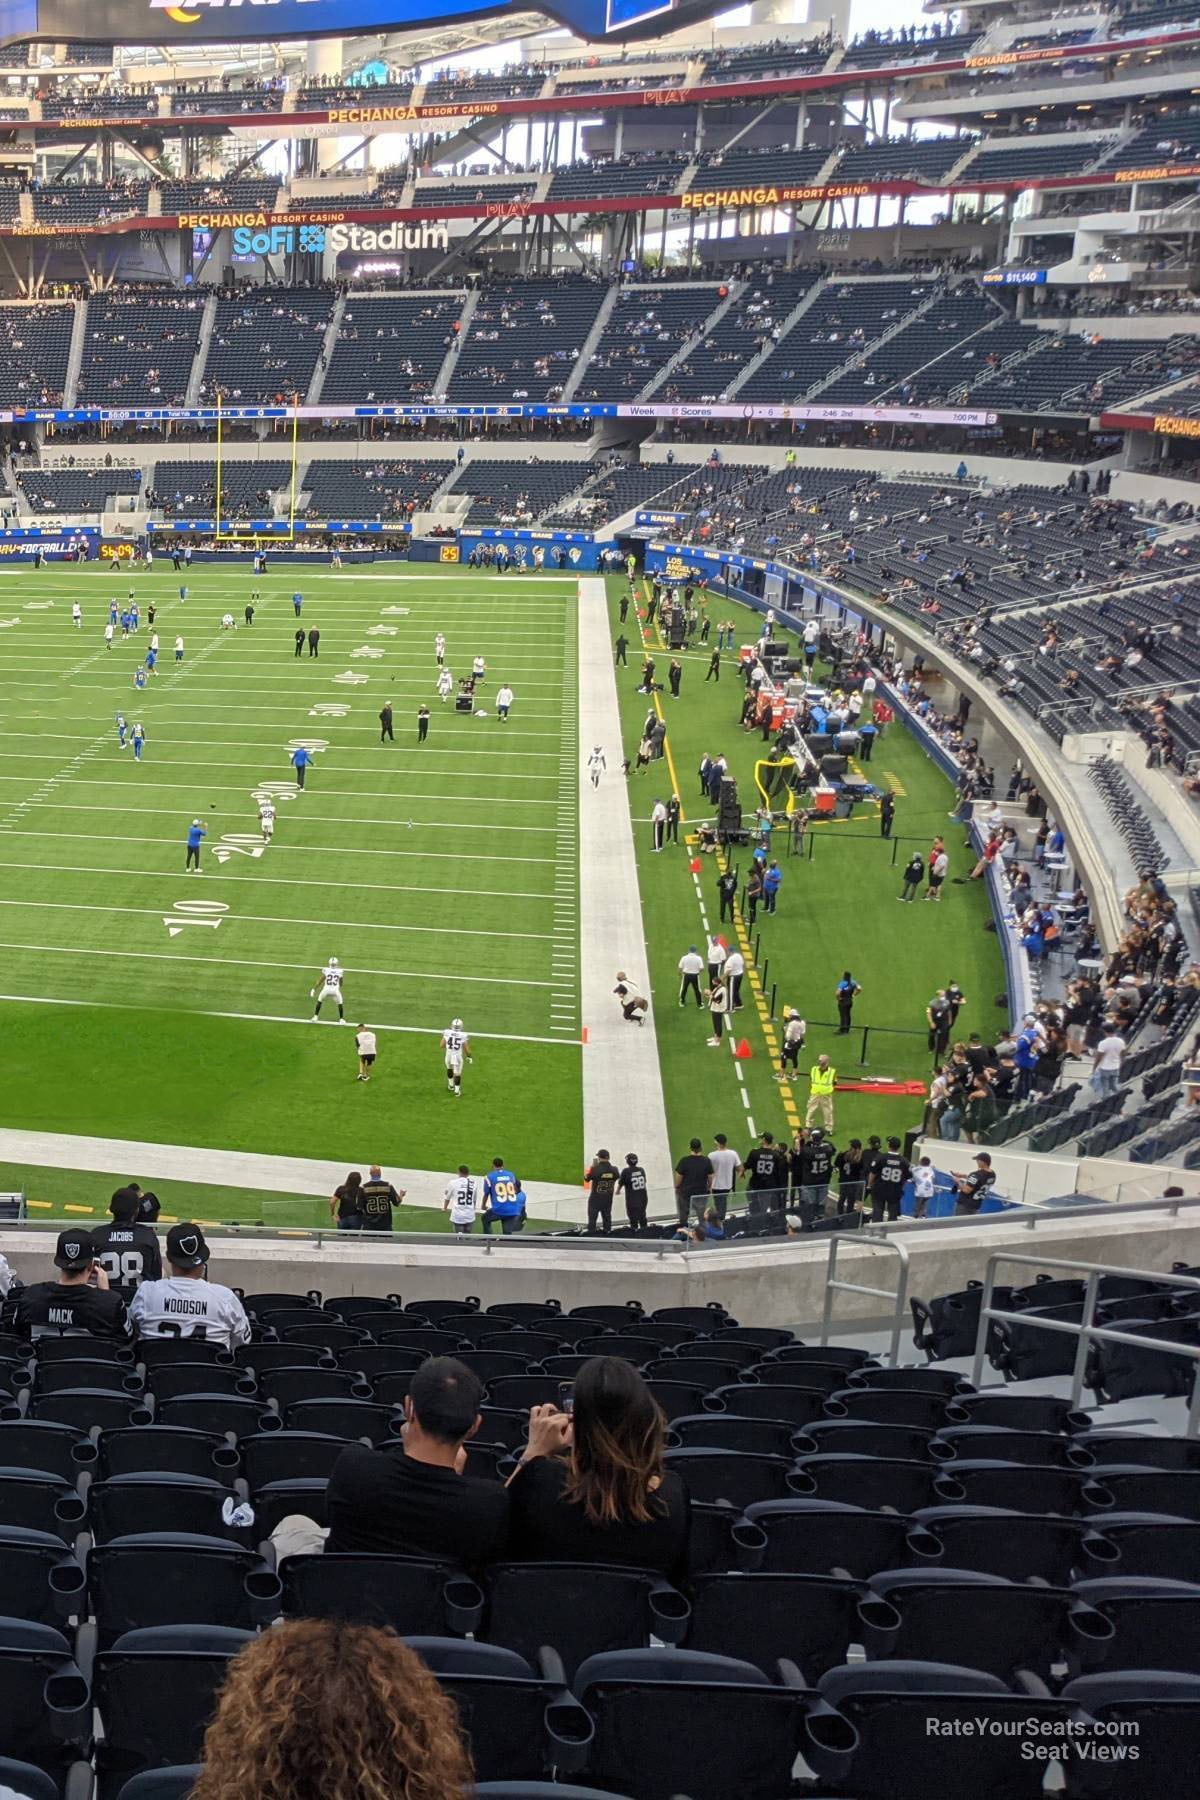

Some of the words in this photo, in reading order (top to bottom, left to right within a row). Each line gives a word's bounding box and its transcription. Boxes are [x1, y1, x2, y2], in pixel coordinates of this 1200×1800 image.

[965, 52, 1017, 68] PECHANGA
[328, 106, 417, 123] PECHANGA
[422, 106, 458, 117] RESORT
[461, 103, 498, 114] CASINO
[59, 119, 104, 128] PECHANGA
[1114, 167, 1168, 182] PECHANGA
[681, 188, 778, 208] PECHANGA
[782, 188, 823, 200] RESORT
[826, 186, 868, 198] CASINO
[486, 202, 530, 217] PLAY
[178, 213, 267, 228] PECHANGA
[271, 214, 307, 223] RESORT
[310, 212, 345, 221] CASINO
[13, 226, 56, 236] PECHANGA
[234, 227, 293, 255] SoFi
[331, 224, 449, 252] Stadium
[1005, 272, 1037, 282] $11,140
[630, 407, 655, 415] Week
[680, 407, 712, 416] Scores
[806, 409, 811, 417] 7
[967, 414, 978, 422] PM
[651, 514, 676, 523] RAMS
[442, 548, 457, 560] 25
[667, 557, 682, 565] LOS
[262, 810, 273, 819] 22
[326, 973, 339, 987] 23
[447, 1036, 462, 1051] 45
[757, 1160, 774, 1175] 83
[811, 1160, 829, 1174] 15
[843, 1162, 851, 1175] 4
[881, 1166, 902, 1183] 98
[631, 1175, 645, 1191] 28
[457, 1190, 473, 1206] 28
[495, 1181, 517, 1203] 99
[366, 1195, 390, 1214] 26
[108, 1231, 134, 1242] JACOBS
[99, 1251, 144, 1287] 28
[163, 1297, 208, 1316] WOODSON
[48, 1307, 73, 1326] MACK
